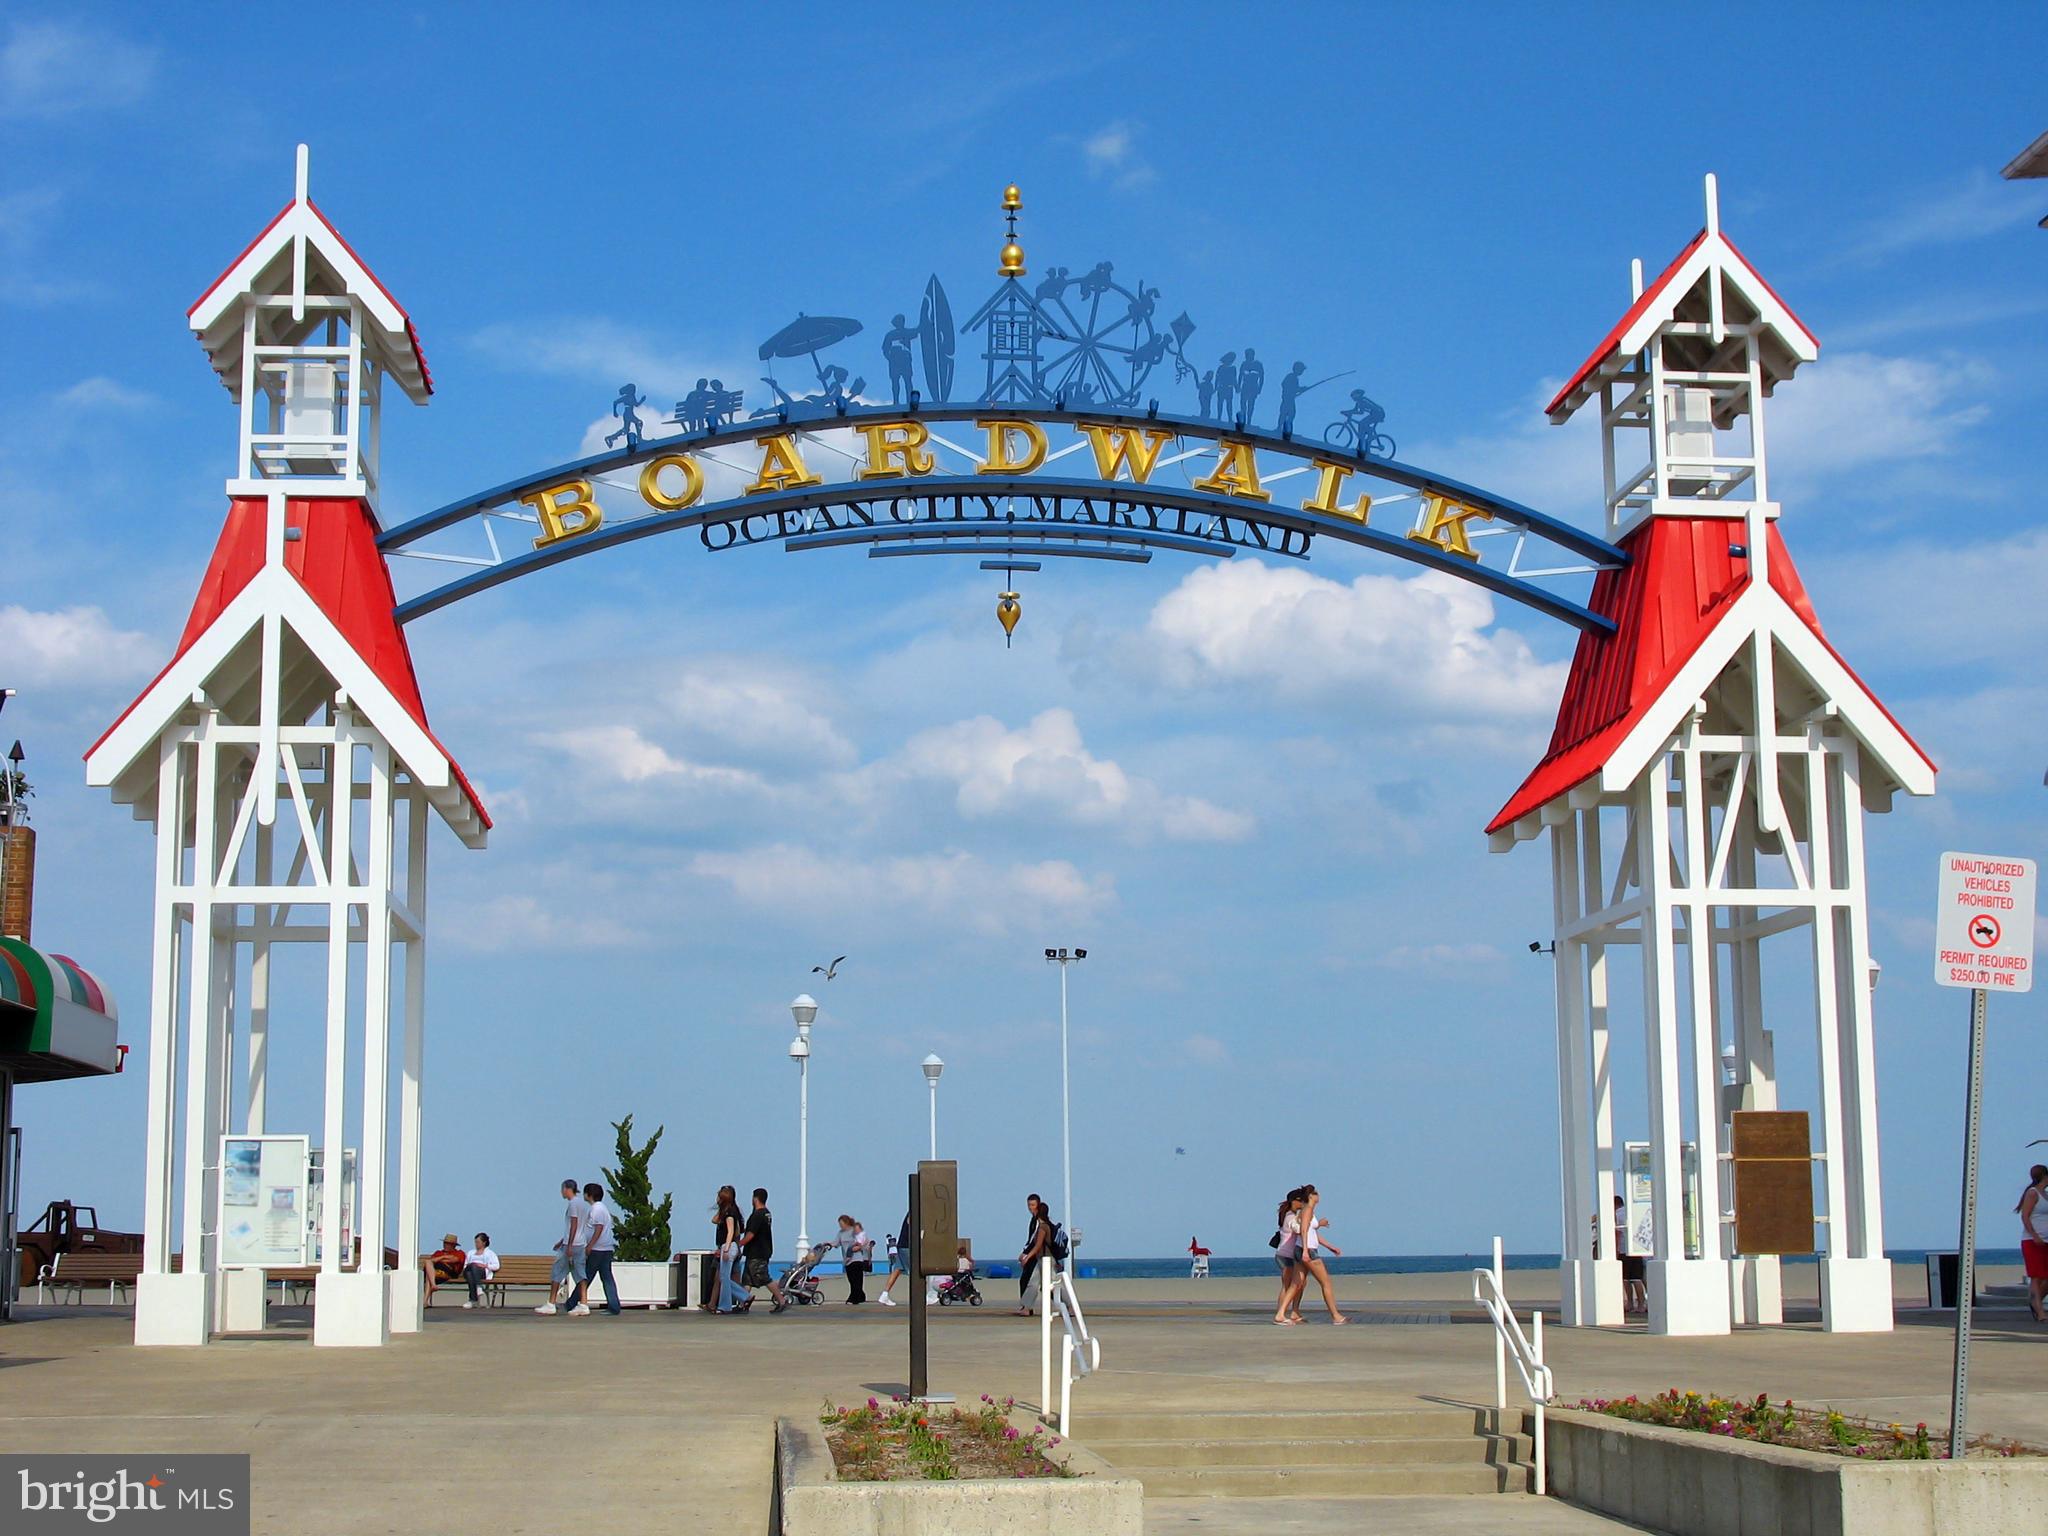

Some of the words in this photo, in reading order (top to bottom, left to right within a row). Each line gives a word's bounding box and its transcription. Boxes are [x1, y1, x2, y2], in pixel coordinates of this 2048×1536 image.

[519, 417, 1493, 562] BOARDWALK
[701, 499, 877, 550] OCEAN
[1026, 496, 1309, 557] MARYLAND
[1951, 859, 2024, 877] UNAUTHORIZED
[1964, 877, 2011, 893] VEHICLES
[1957, 892, 2014, 909] PROHIBITED
[1940, 950, 1975, 965] PERMIT
[1978, 954, 2027, 970] REQUIRED
[1950, 967, 1990, 984] $250.00
[1993, 973, 2016, 986] FINE
